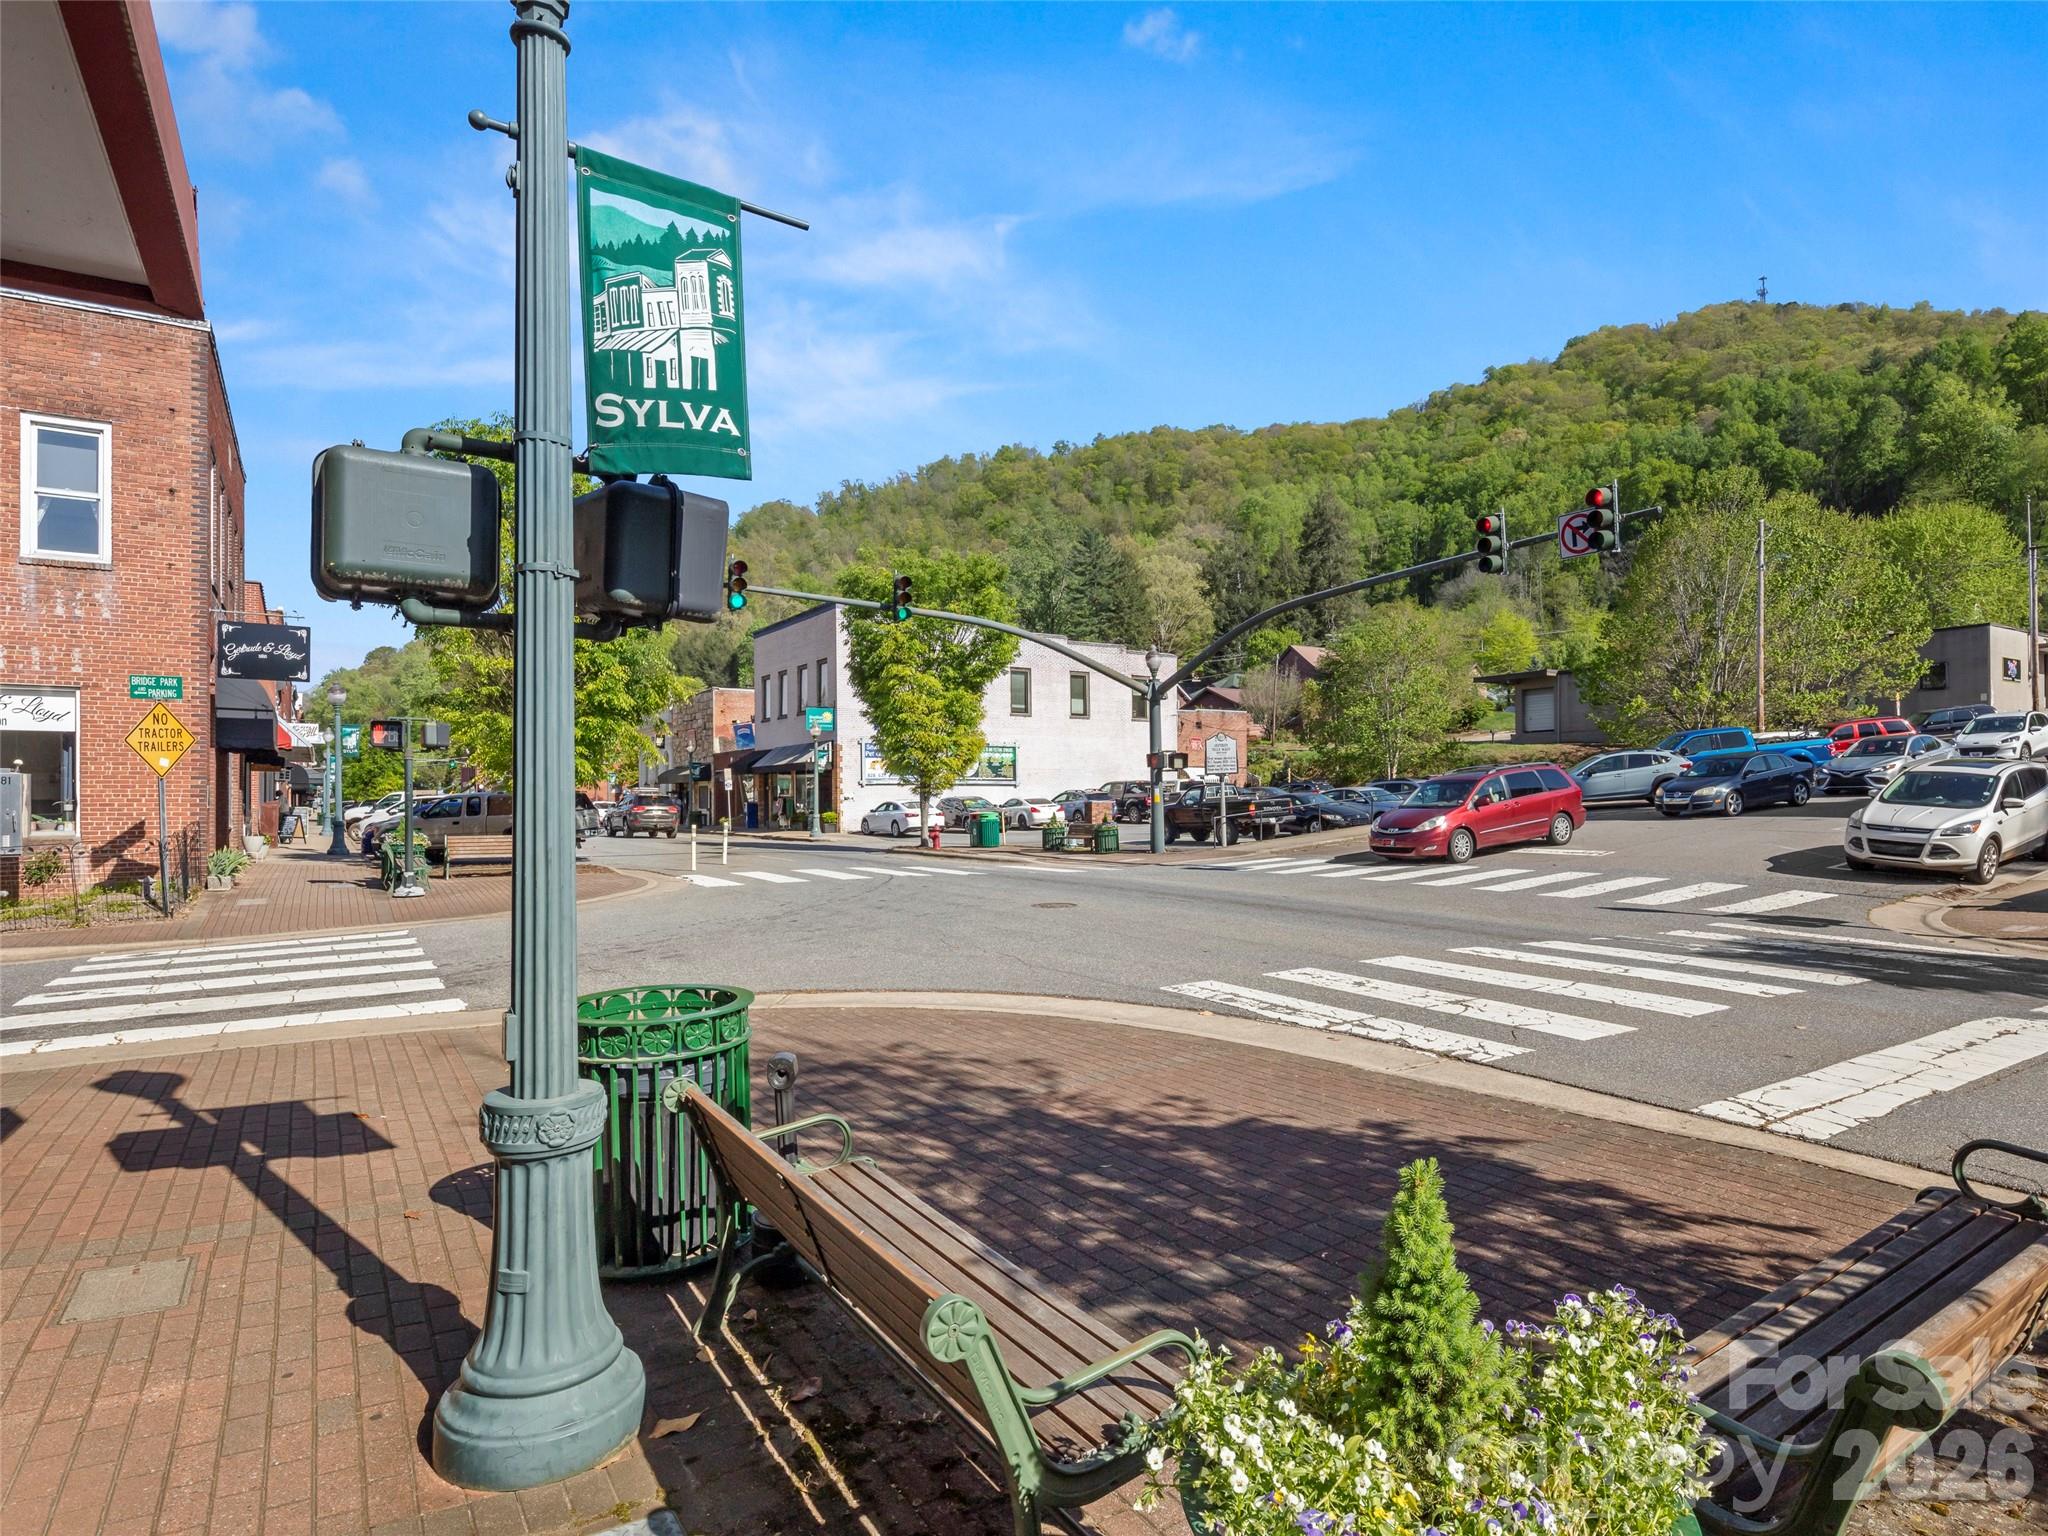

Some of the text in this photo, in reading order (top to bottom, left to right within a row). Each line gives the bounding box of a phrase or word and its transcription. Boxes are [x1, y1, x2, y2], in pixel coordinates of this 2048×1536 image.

[594, 392, 741, 437] SYLVA
[263, 642, 275, 653] &
[273, 644, 306, 660] Lloyd
[131, 676, 178, 687] BRIDGE PARK
[147, 688, 177, 698] PARKING
[12, 697, 71, 722] Lloyd
[152, 713, 168, 725] NO
[139, 728, 183, 738] TRACTOR
[138, 741, 184, 752] TRAILERS
